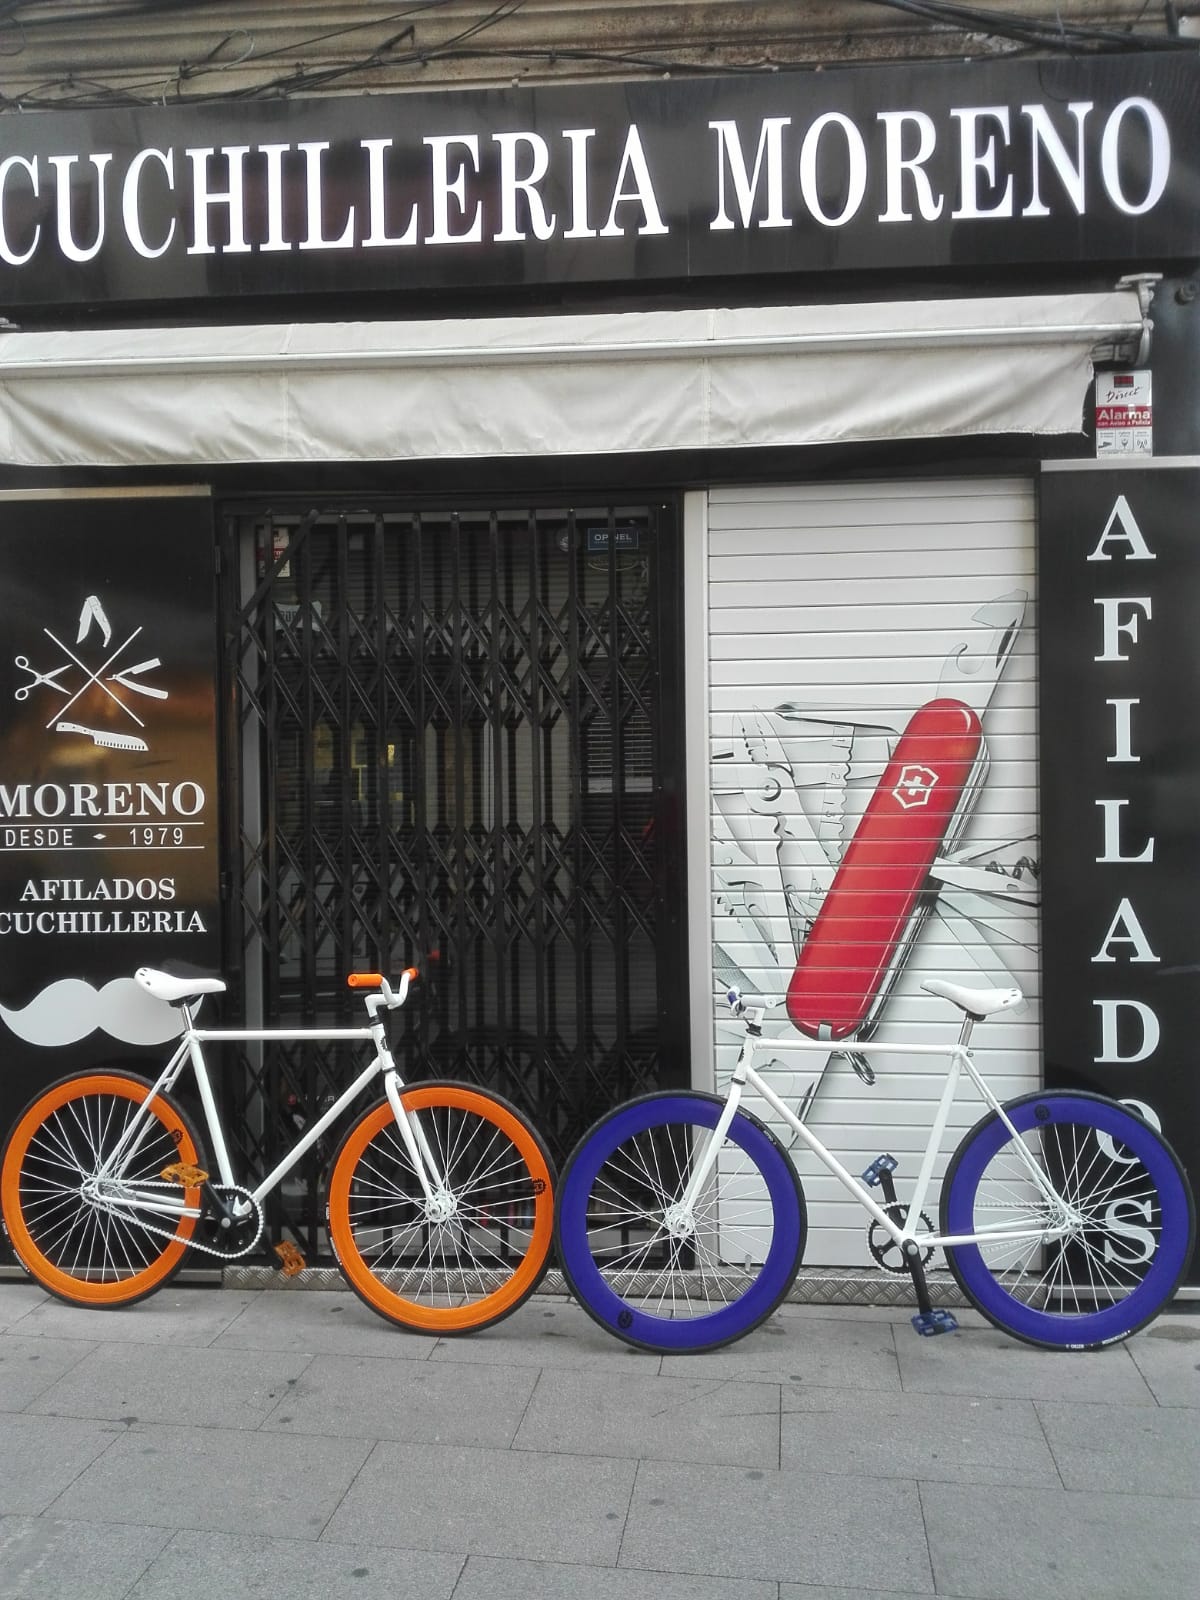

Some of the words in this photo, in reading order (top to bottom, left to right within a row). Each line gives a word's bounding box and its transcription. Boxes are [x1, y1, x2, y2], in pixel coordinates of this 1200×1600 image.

[0, 124, 668, 266] CUCHILLERIA
[708, 96, 1171, 230] MORENO
[1098, 408, 1150, 420] Alarma
[594, 533, 632, 541] OPNEL
[0, 782, 205, 817] MORENO
[5, 829, 73, 846] DESDE
[129, 828, 183, 845] 1979
[20, 878, 176, 901] AFILADOS
[0, 911, 207, 935] CUCHILLERIA
